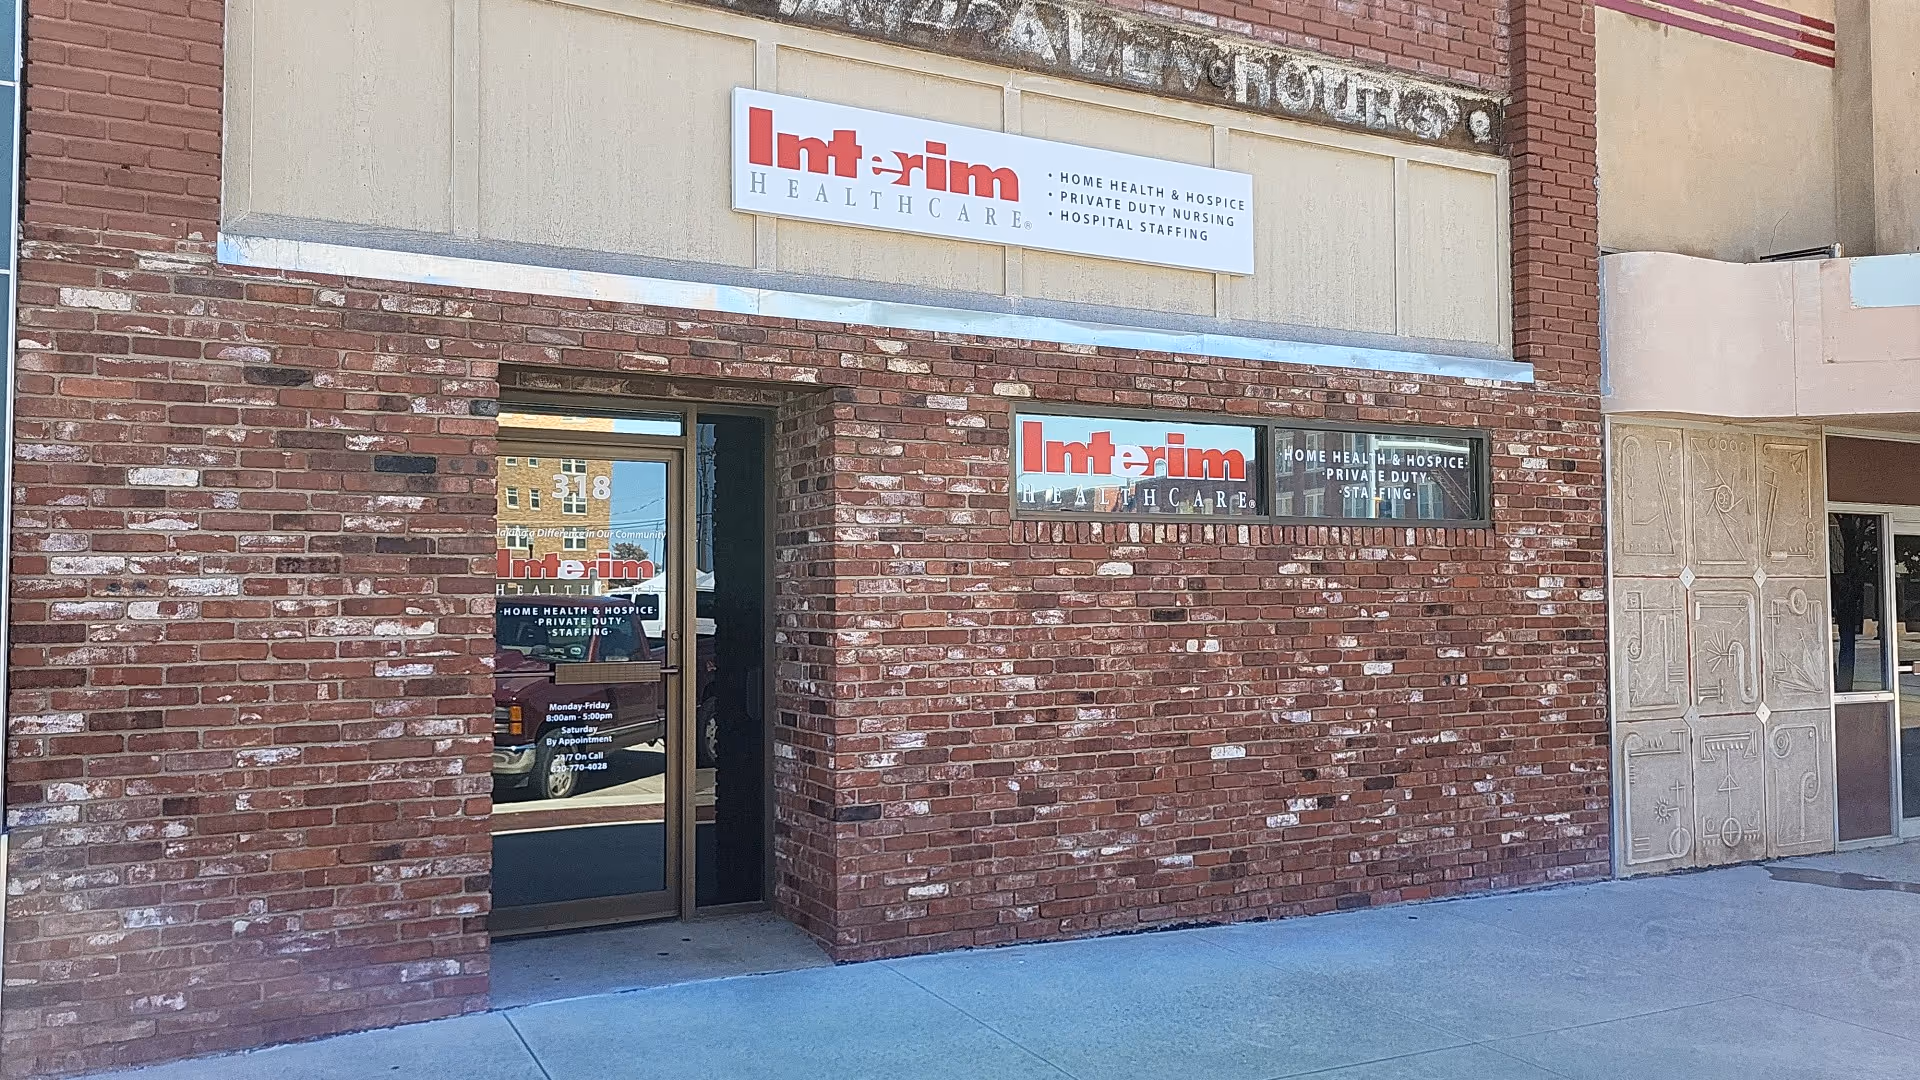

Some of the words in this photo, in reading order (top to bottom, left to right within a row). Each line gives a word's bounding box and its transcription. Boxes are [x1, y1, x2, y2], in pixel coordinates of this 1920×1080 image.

[748, 106, 1020, 202] Interim
[1060, 172, 1103, 189] HOME
[1110, 179, 1164, 198] HEALTH
[1171, 190, 1180, 201] &
[1186, 192, 1245, 211] HOSPICE
[1060, 191, 1121, 210] PRIVATE
[1128, 201, 1166, 217] DUTY
[1173, 208, 1235, 227] NURSING
[1060, 210, 1133, 231] HOSPITAL
[1140, 221, 1208, 241] STAFFING
[1021, 419, 1247, 481] Interim
[1284, 447, 1326, 463] HOME
[1332, 451, 1386, 466] HEALTH
[1392, 453, 1401, 466] &
[1406, 455, 1464, 469] HOSPICE
[1326, 468, 1385, 482] PRIVATE
[1391, 470, 1428, 484] DUTY
[551, 473, 611, 500] 318
[1342, 486, 1411, 500] STAFFING
[528, 530, 536, 538] a
[537, 528, 586, 539] Difference
[586, 529, 595, 539] in
[596, 529, 614, 539] Our
[615, 529, 667, 541] Community
[496, 548, 656, 580] Interim
[503, 607, 539, 616] HOME
[543, 606, 588, 615] HEALTH
[592, 606, 600, 615] &
[605, 606, 654, 615] HOSPICE
[538, 617, 587, 626] PRIVATE
[591, 617, 623, 626] DUTY
[551, 627, 609, 637] STAFFING
[549, 701, 611, 711] Monday-Friday
[545, 714, 577, 722] 8:00am
[582, 713, 613, 721] 5:00pm
[561, 725, 598, 735] Saturday
[546, 738, 557, 747] By
[558, 735, 613, 746] Appointment
[554, 753, 574, 761] 24/7
[588, 752, 604, 760] Call
